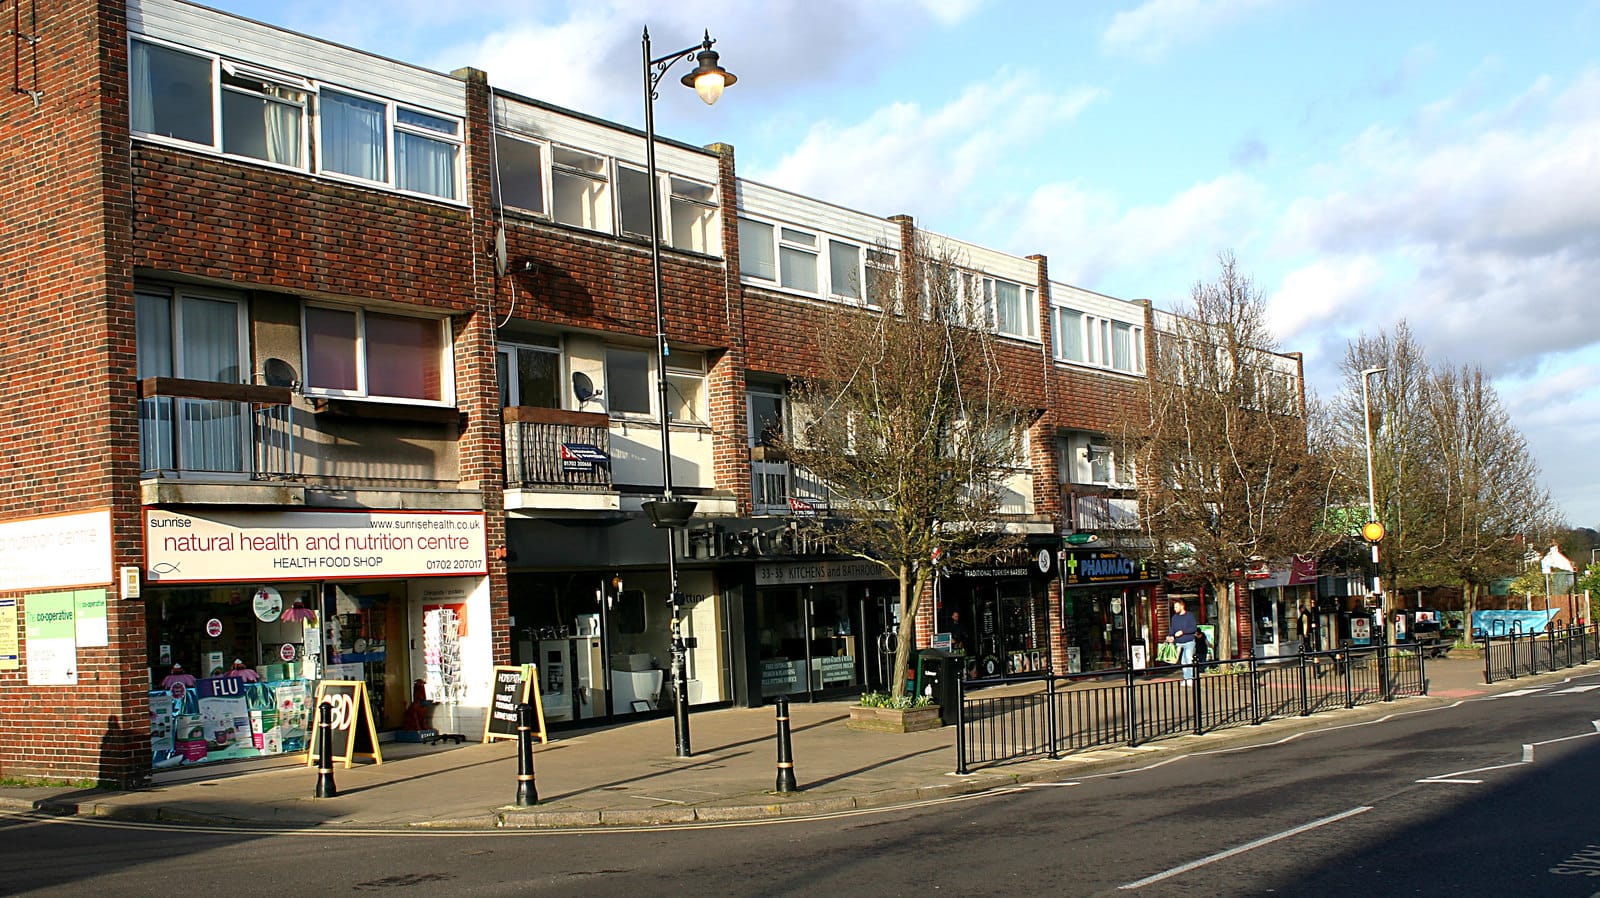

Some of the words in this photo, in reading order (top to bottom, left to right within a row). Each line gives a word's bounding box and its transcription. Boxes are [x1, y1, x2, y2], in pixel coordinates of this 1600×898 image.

[150, 517, 191, 528] sunrise
[370, 520, 480, 530] www.sunrisehealth.co.uk
[164, 533, 234, 551] natural
[240, 532, 299, 551] health
[306, 532, 340, 551] and
[345, 533, 413, 551] nutrition
[417, 534, 469, 550] centre
[273, 557, 317, 568] HEALTH
[319, 557, 351, 567] FOOD
[353, 556, 383, 567] SHOP
[426, 560, 452, 570] 01702
[453, 559, 482, 569] 207017
[1080, 559, 1135, 576] PHARMACY
[761, 568, 784, 579] 33-35
[788, 566, 826, 580] KITCHENS
[828, 566, 841, 577] and
[842, 563, 884, 577] BATHROOM
[964, 569, 992, 577] TRADITIONAL
[992, 568, 1010, 576] TURKISH
[1010, 568, 1028, 576] BARBERS
[36, 610, 73, 623] co-operative
[212, 678, 239, 696] FLU
